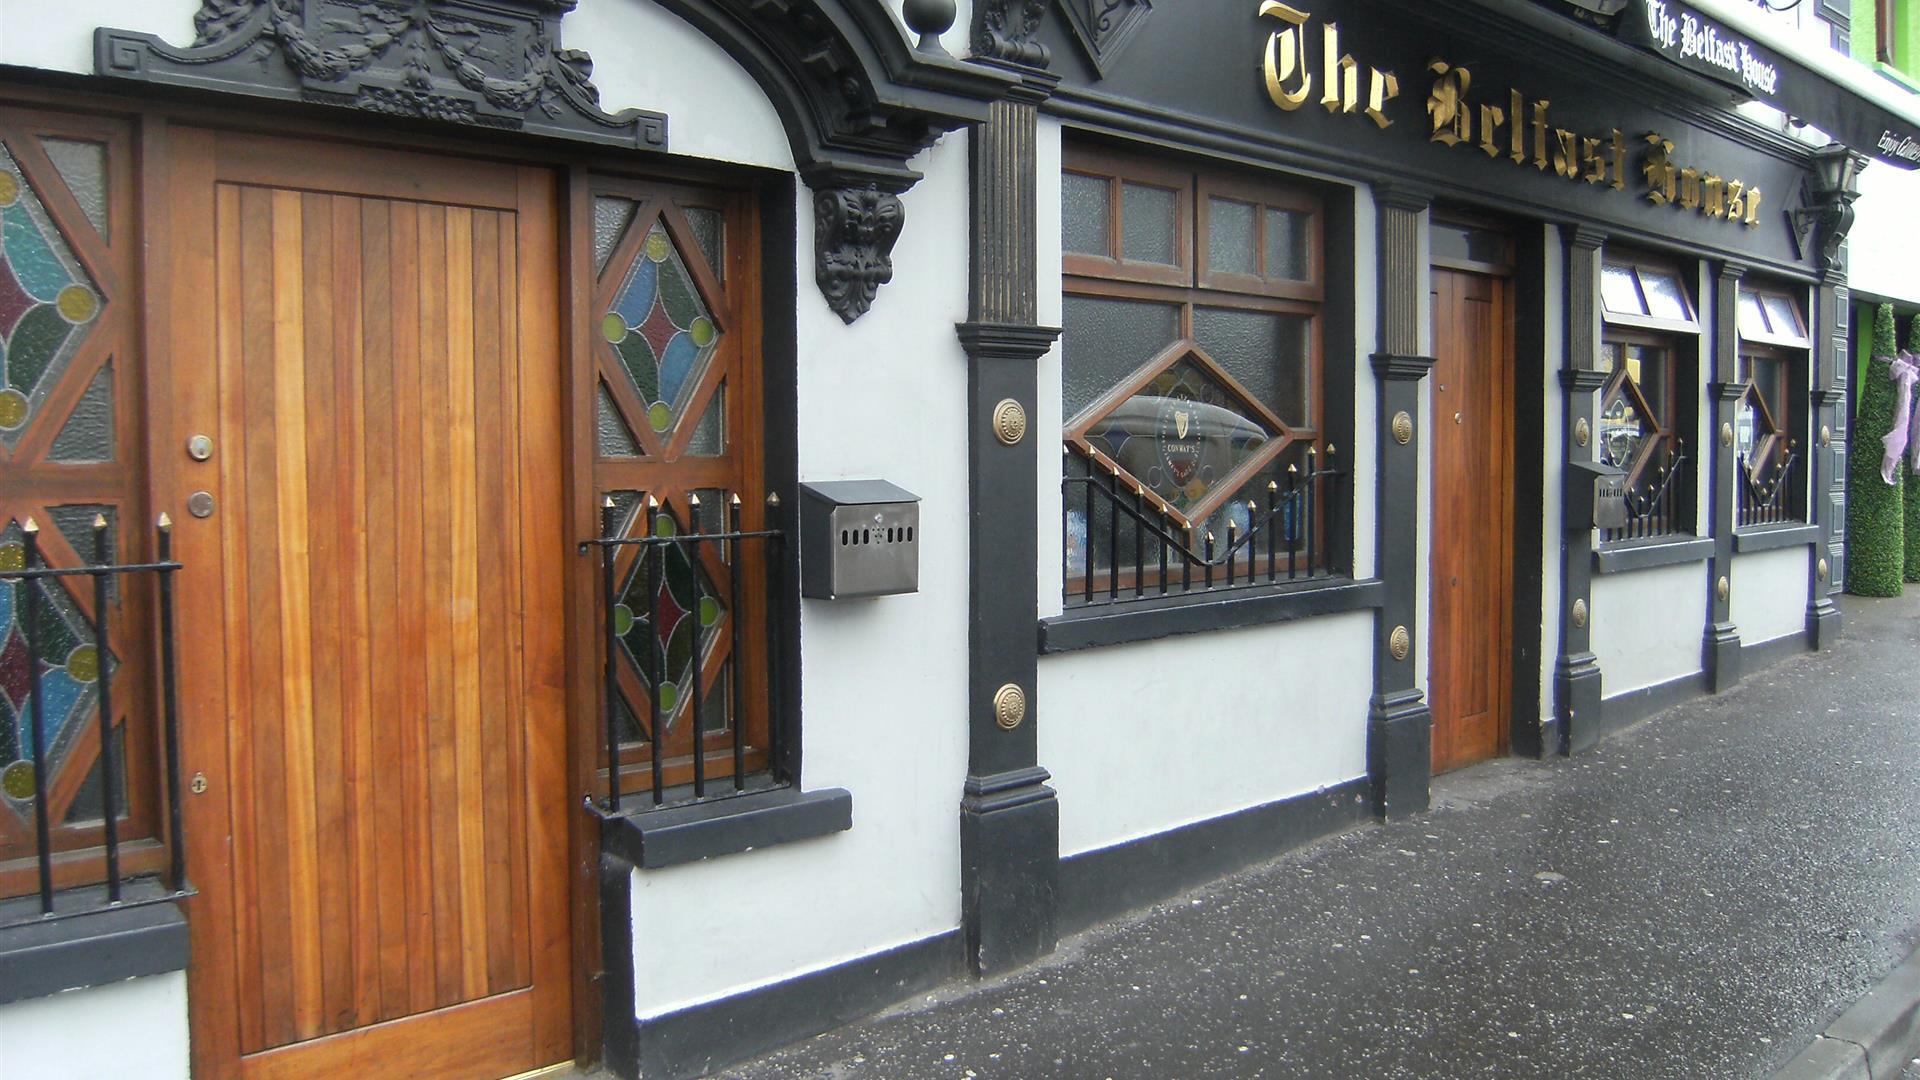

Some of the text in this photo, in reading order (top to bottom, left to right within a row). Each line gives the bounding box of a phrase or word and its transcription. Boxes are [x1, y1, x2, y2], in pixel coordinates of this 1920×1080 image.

[1646, 0, 1777, 95] The Belfast House
[1258, 0, 1762, 230] The Belfast House
[1877, 130, 1900, 157] Enjoy
